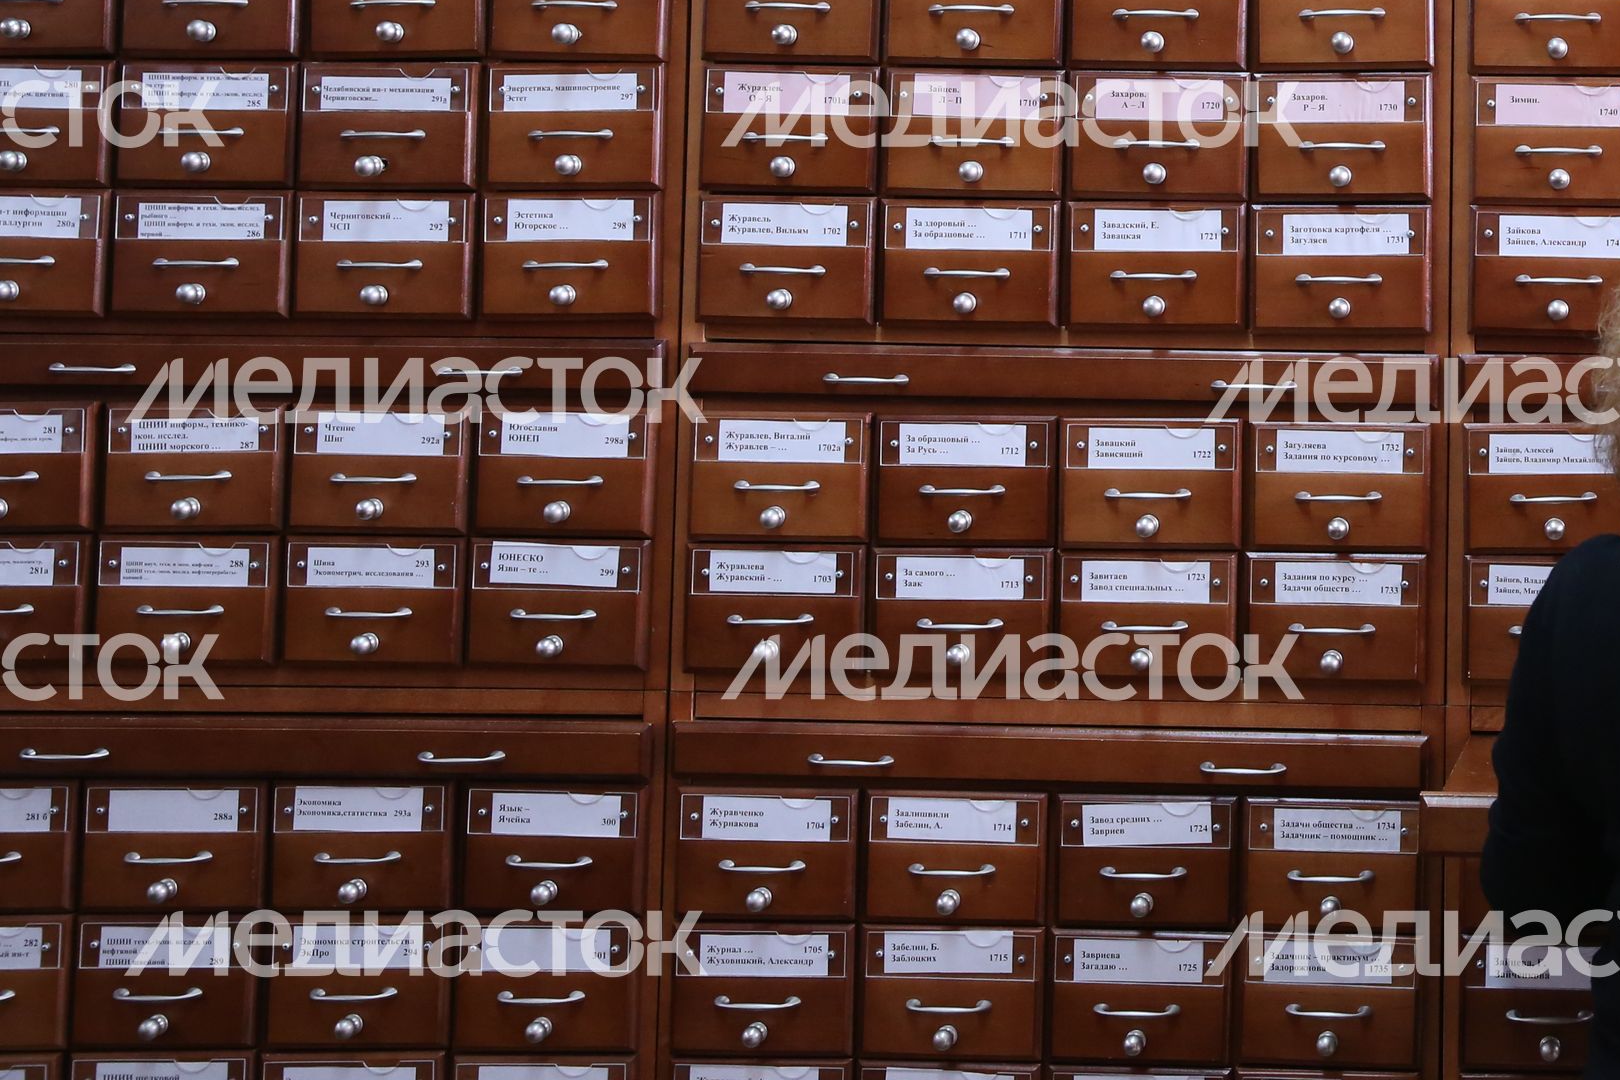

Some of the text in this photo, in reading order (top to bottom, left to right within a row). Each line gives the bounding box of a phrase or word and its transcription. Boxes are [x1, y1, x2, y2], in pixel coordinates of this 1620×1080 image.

[1292, 93, 1328, 102] Захаров.
[330, 212, 390, 221] Черниговский
[728, 214, 771, 224] Журавель
[330, 223, 350, 231] ЧСП
[429, 223, 443, 231] 292
[514, 222, 557, 231] Югорское
[612, 222, 629, 230] 298
[776, 226, 808, 234] Вильям
[1335, 226, 1380, 235] картофеля
[1201, 232, 1218, 240] 1721
[1387, 236, 1404, 244] 1731
[1540, 239, 1586, 248] Александр
[509, 424, 558, 432] Югославия
[509, 434, 540, 442] ЮНЕП
[774, 432, 810, 440] Виталий
[819, 444, 841, 452] 1702а
[918, 446, 937, 455] Русь
[1095, 450, 1143, 458] Зависящий
[1194, 450, 1212, 458] 1722
[499, 553, 544, 562] ЮНЕСКО
[416, 560, 430, 568] 293
[716, 562, 764, 571] Журавлева
[814, 575, 832, 583] 1703
[1188, 573, 1206, 581] 1723
[1332, 576, 1356, 584] курсу
[902, 579, 923, 587] Заак
[1381, 586, 1399, 594] 1733
[297, 798, 342, 806] Экономика
[499, 804, 523, 812] Язык
[710, 808, 764, 818] Журавченко
[498, 815, 530, 823] Ячейка
[807, 822, 824, 830] 1704
[1378, 822, 1396, 830] 1734
[1090, 827, 1125, 836] Завриев
[707, 945, 742, 955] Журнал
[804, 946, 822, 954] 1705
[891, 954, 936, 962] Заблоцких
